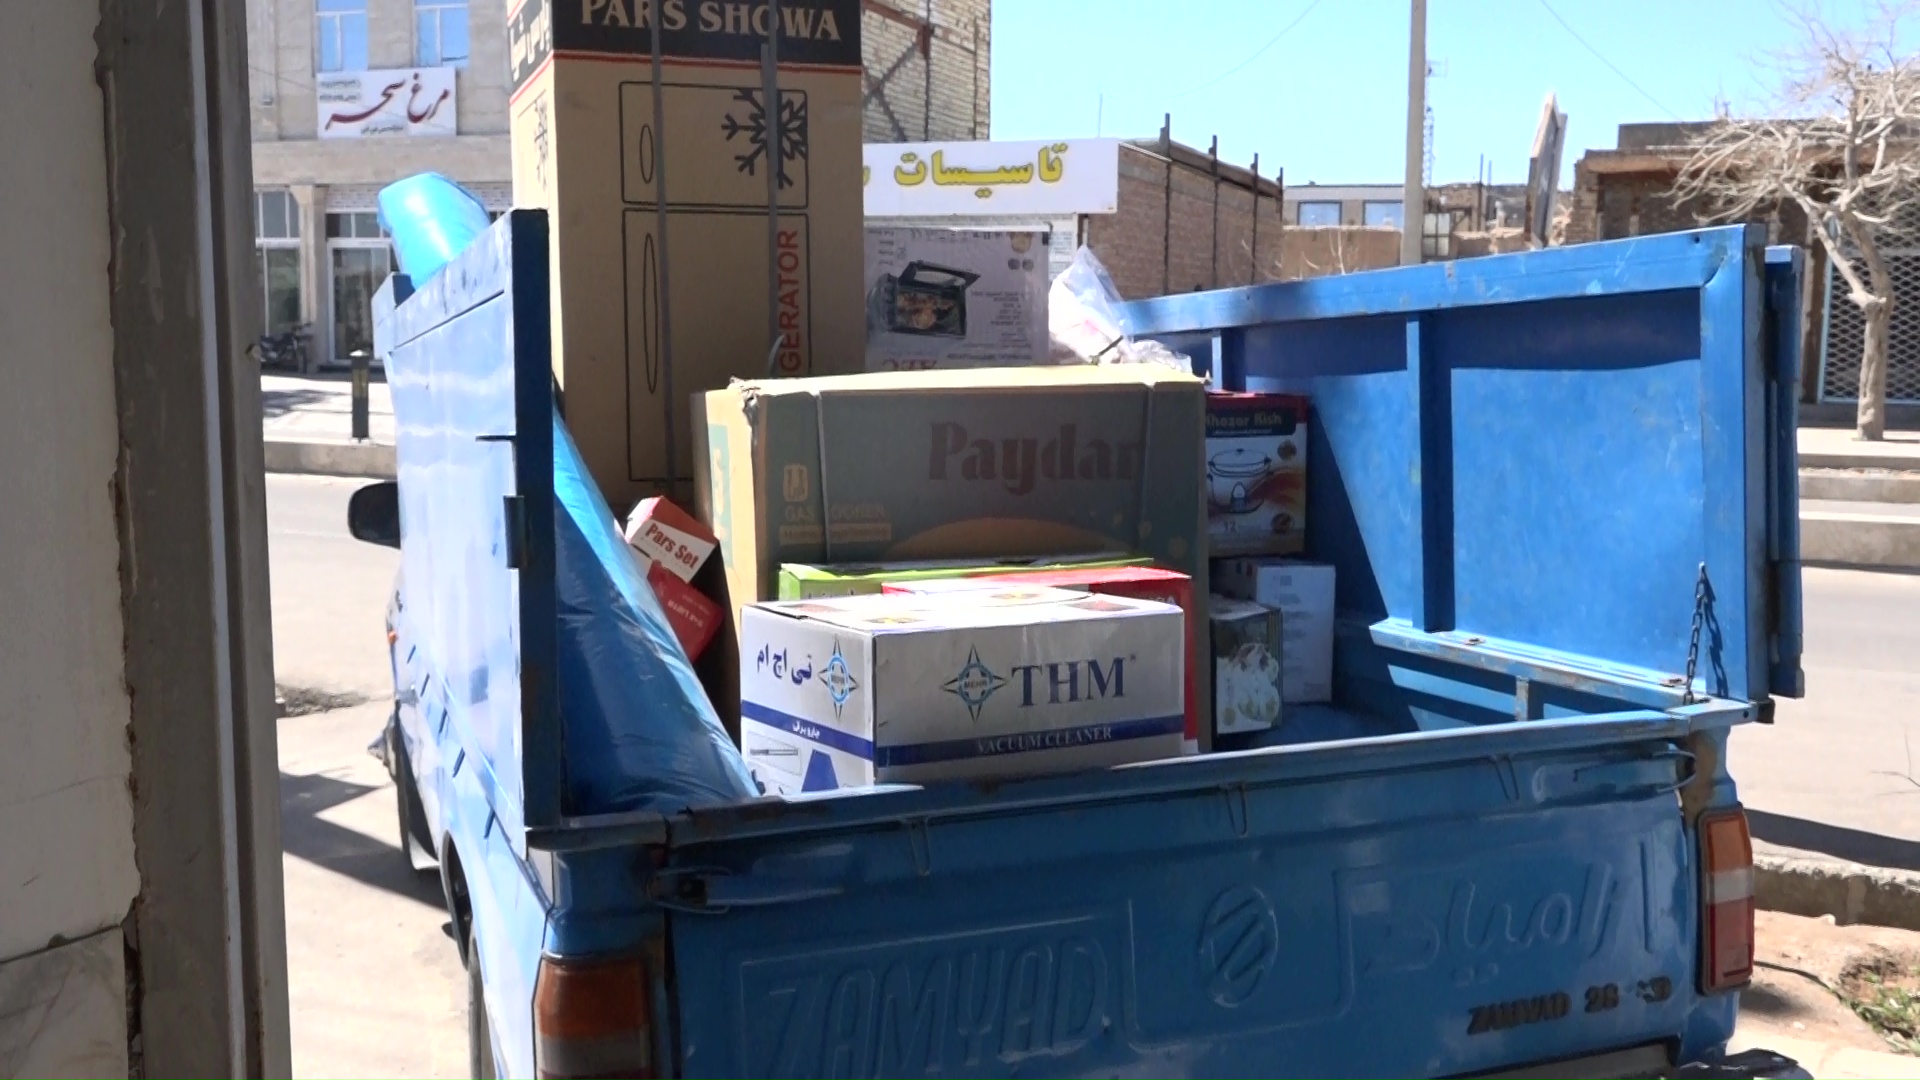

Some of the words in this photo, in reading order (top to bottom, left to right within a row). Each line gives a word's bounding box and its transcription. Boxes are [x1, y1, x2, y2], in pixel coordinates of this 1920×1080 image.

[581, 0, 687, 30] PARS
[699, 1, 842, 42] SHOWA
[325, 77, 406, 131] سحر
[407, 72, 450, 124] مرغ
[894, 143, 1068, 199] تاسیسات
[929, 421, 1141, 496] Paydar
[645, 522, 677, 553] Pars
[675, 544, 699, 568] Set
[1011, 656, 1126, 708] THM
[977, 732, 1041, 755] VACUUM
[1045, 726, 1112, 749] CLEANER
[767, 937, 1110, 1080] ZAMYAD
